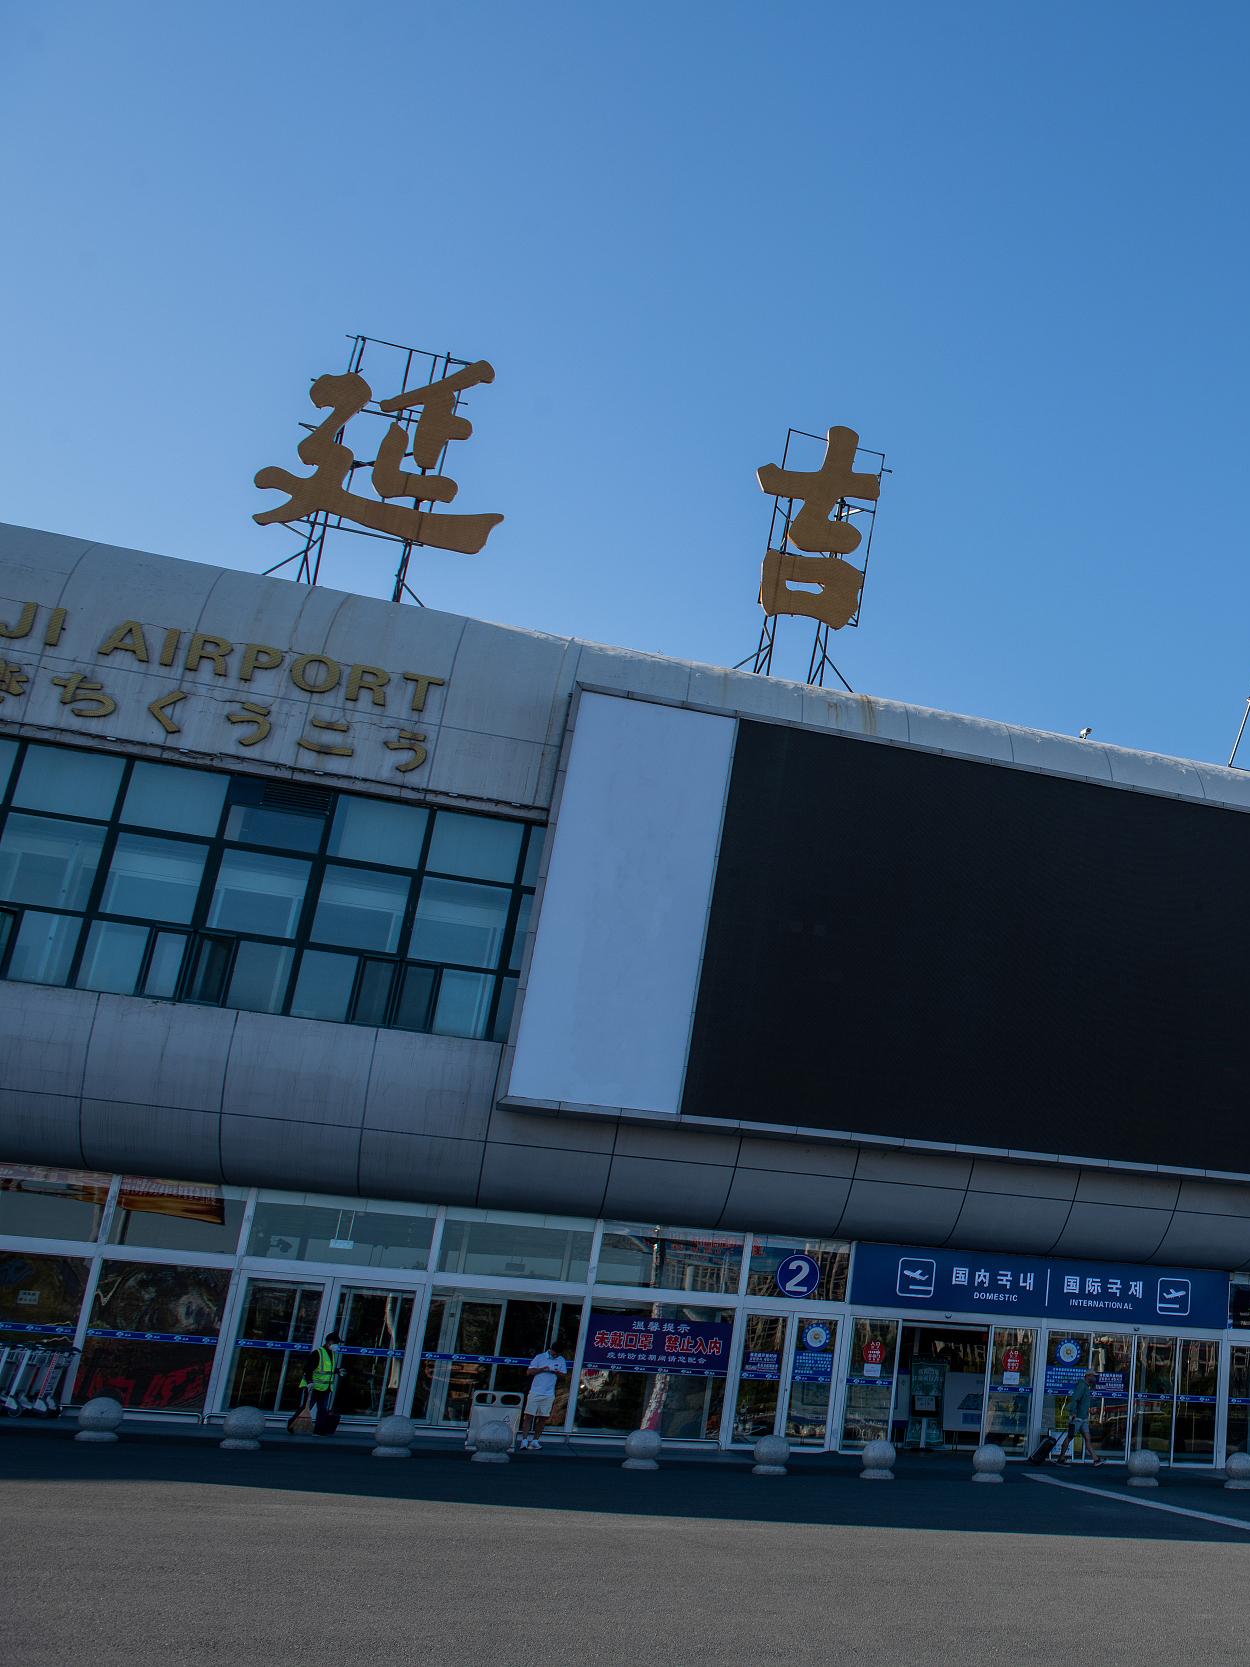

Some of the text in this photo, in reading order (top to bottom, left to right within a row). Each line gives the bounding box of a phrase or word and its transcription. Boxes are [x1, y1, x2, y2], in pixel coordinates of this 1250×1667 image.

[0, 602, 445, 712] JI AIRPORT
[785, 1260, 810, 1292] 2
[951, 1266, 1035, 1292] 国内 국내
[1063, 1275, 1144, 1299] 国际 국제
[973, 1291, 1019, 1302] DOMESTIC
[1069, 1298, 1134, 1310] INTERNATIONAL
[632, 1320, 691, 1334] 温馨提示
[594, 1329, 723, 1356] 未戴口罩 禁止入内
